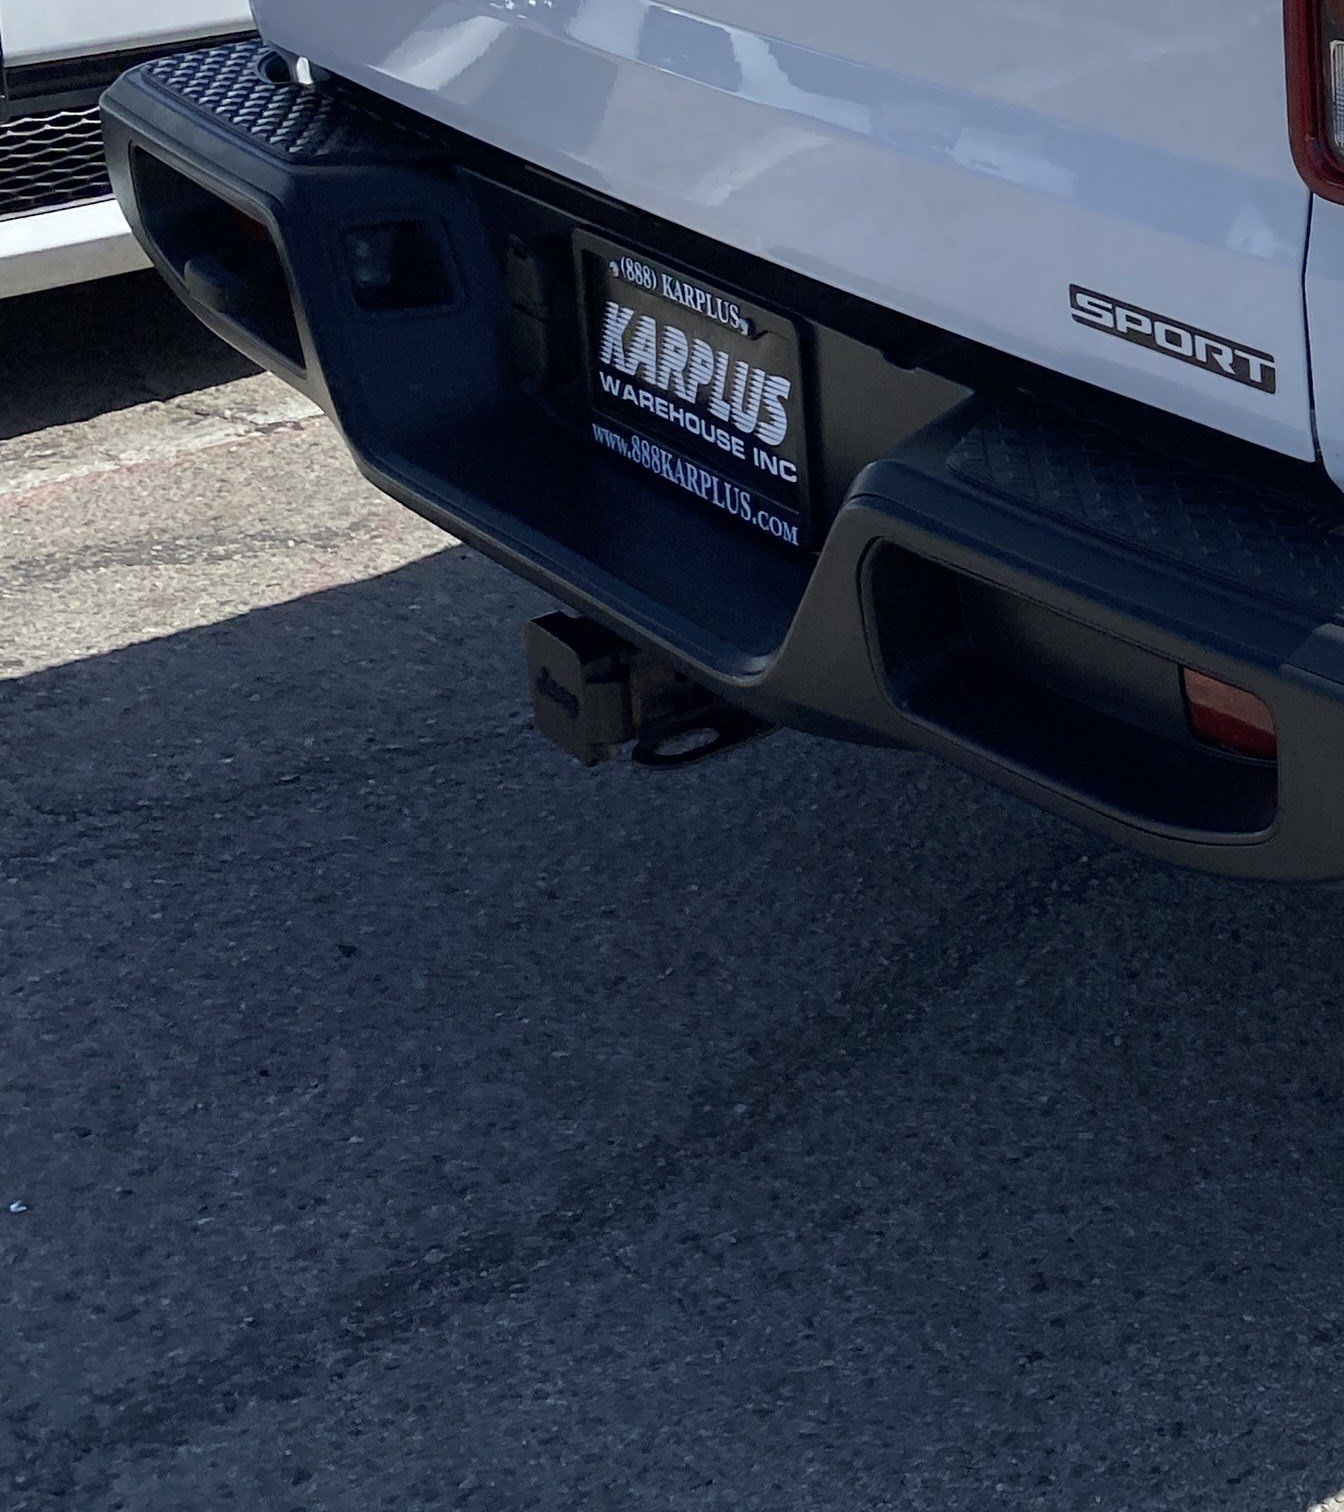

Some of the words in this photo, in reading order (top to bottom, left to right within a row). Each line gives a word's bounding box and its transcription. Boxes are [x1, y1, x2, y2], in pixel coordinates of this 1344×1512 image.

[620, 255, 657, 291] (888)
[661, 273, 740, 329] KARPLUS
[1070, 290, 1277, 385] SPORT
[599, 300, 791, 447] KARPLUS
[599, 370, 746, 460] WAREHOUSE
[752, 446, 798, 483] INC
